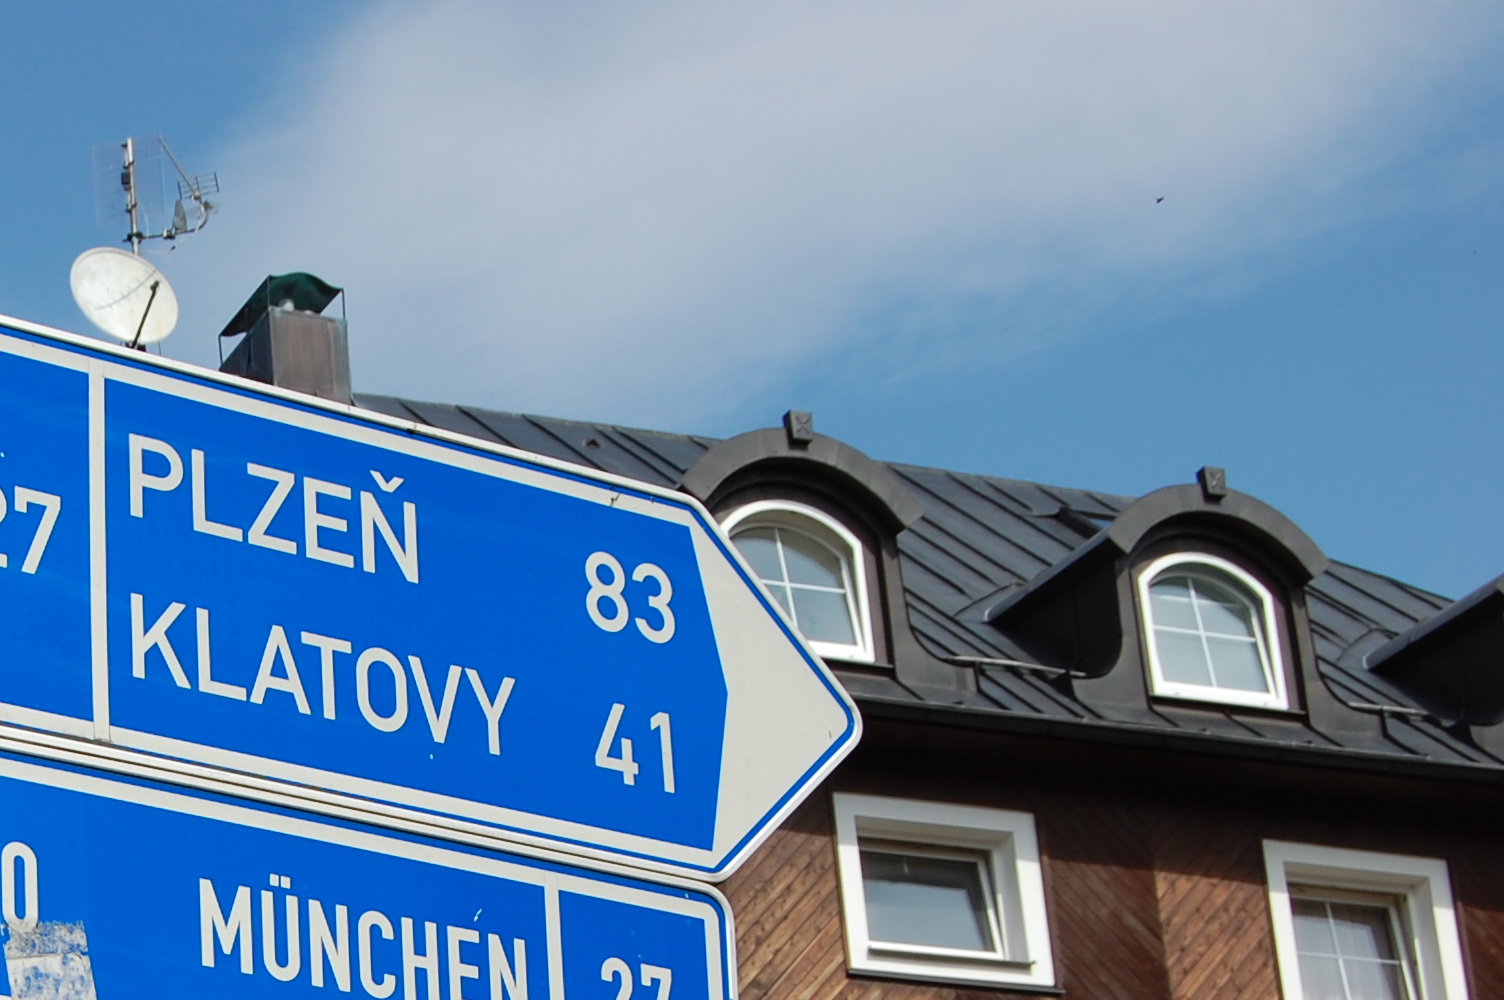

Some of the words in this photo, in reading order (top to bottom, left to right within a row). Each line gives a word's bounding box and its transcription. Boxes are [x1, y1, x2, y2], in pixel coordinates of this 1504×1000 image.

[128, 433, 419, 584] PLZEŇ
[585, 551, 676, 644] 83
[130, 592, 516, 756] KLATOVY
[594, 702, 675, 794] 41
